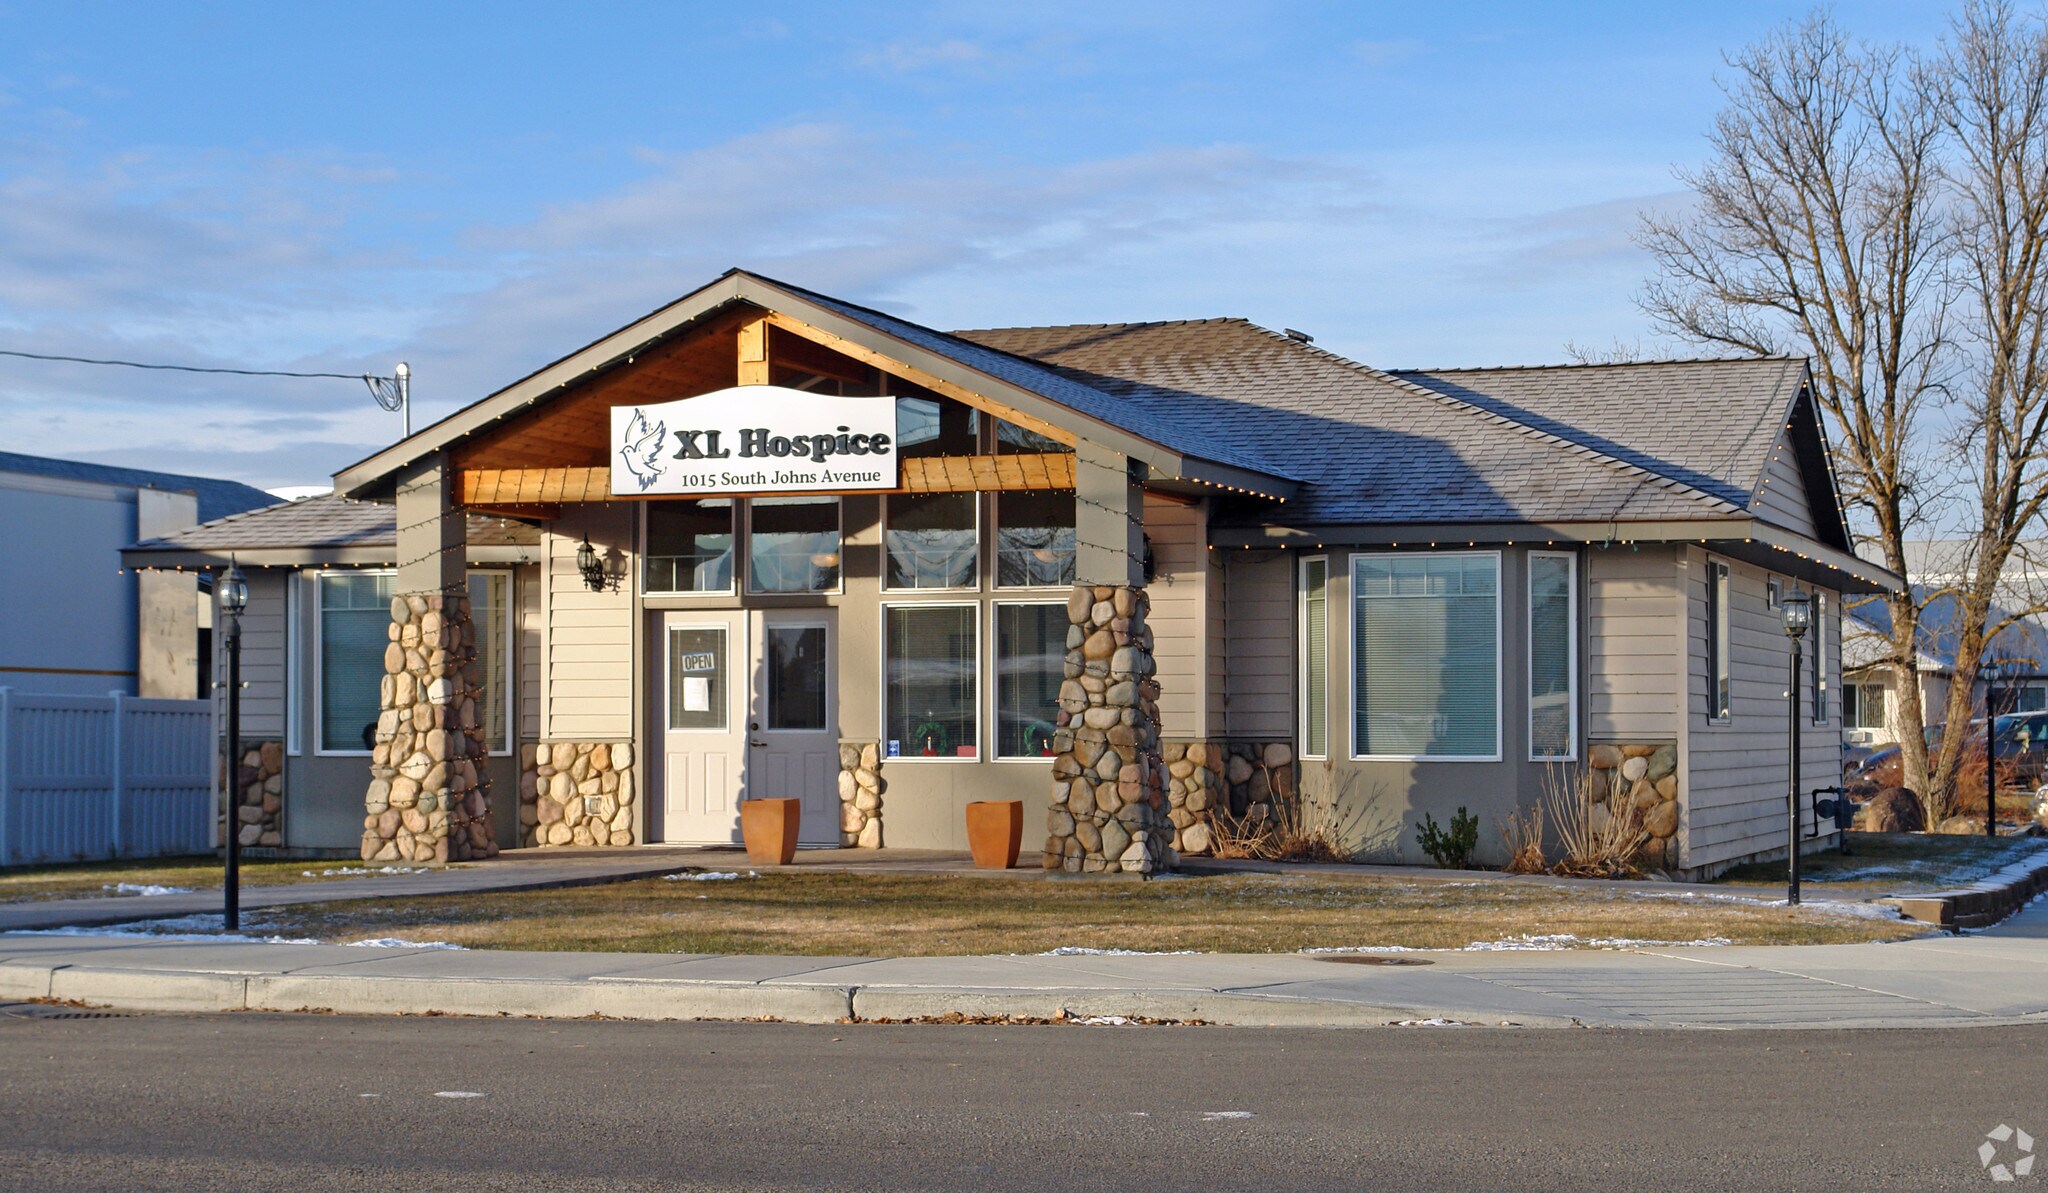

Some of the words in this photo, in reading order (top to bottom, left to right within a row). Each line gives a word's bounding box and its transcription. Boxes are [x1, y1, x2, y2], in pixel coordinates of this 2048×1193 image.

[673, 430, 731, 460] XL
[738, 425, 892, 463] Hospice
[682, 474, 716, 488] 1015
[721, 471, 767, 486] South
[771, 470, 818, 484] Johns
[820, 469, 881, 483] Avenue
[685, 654, 712, 670] OPEN
